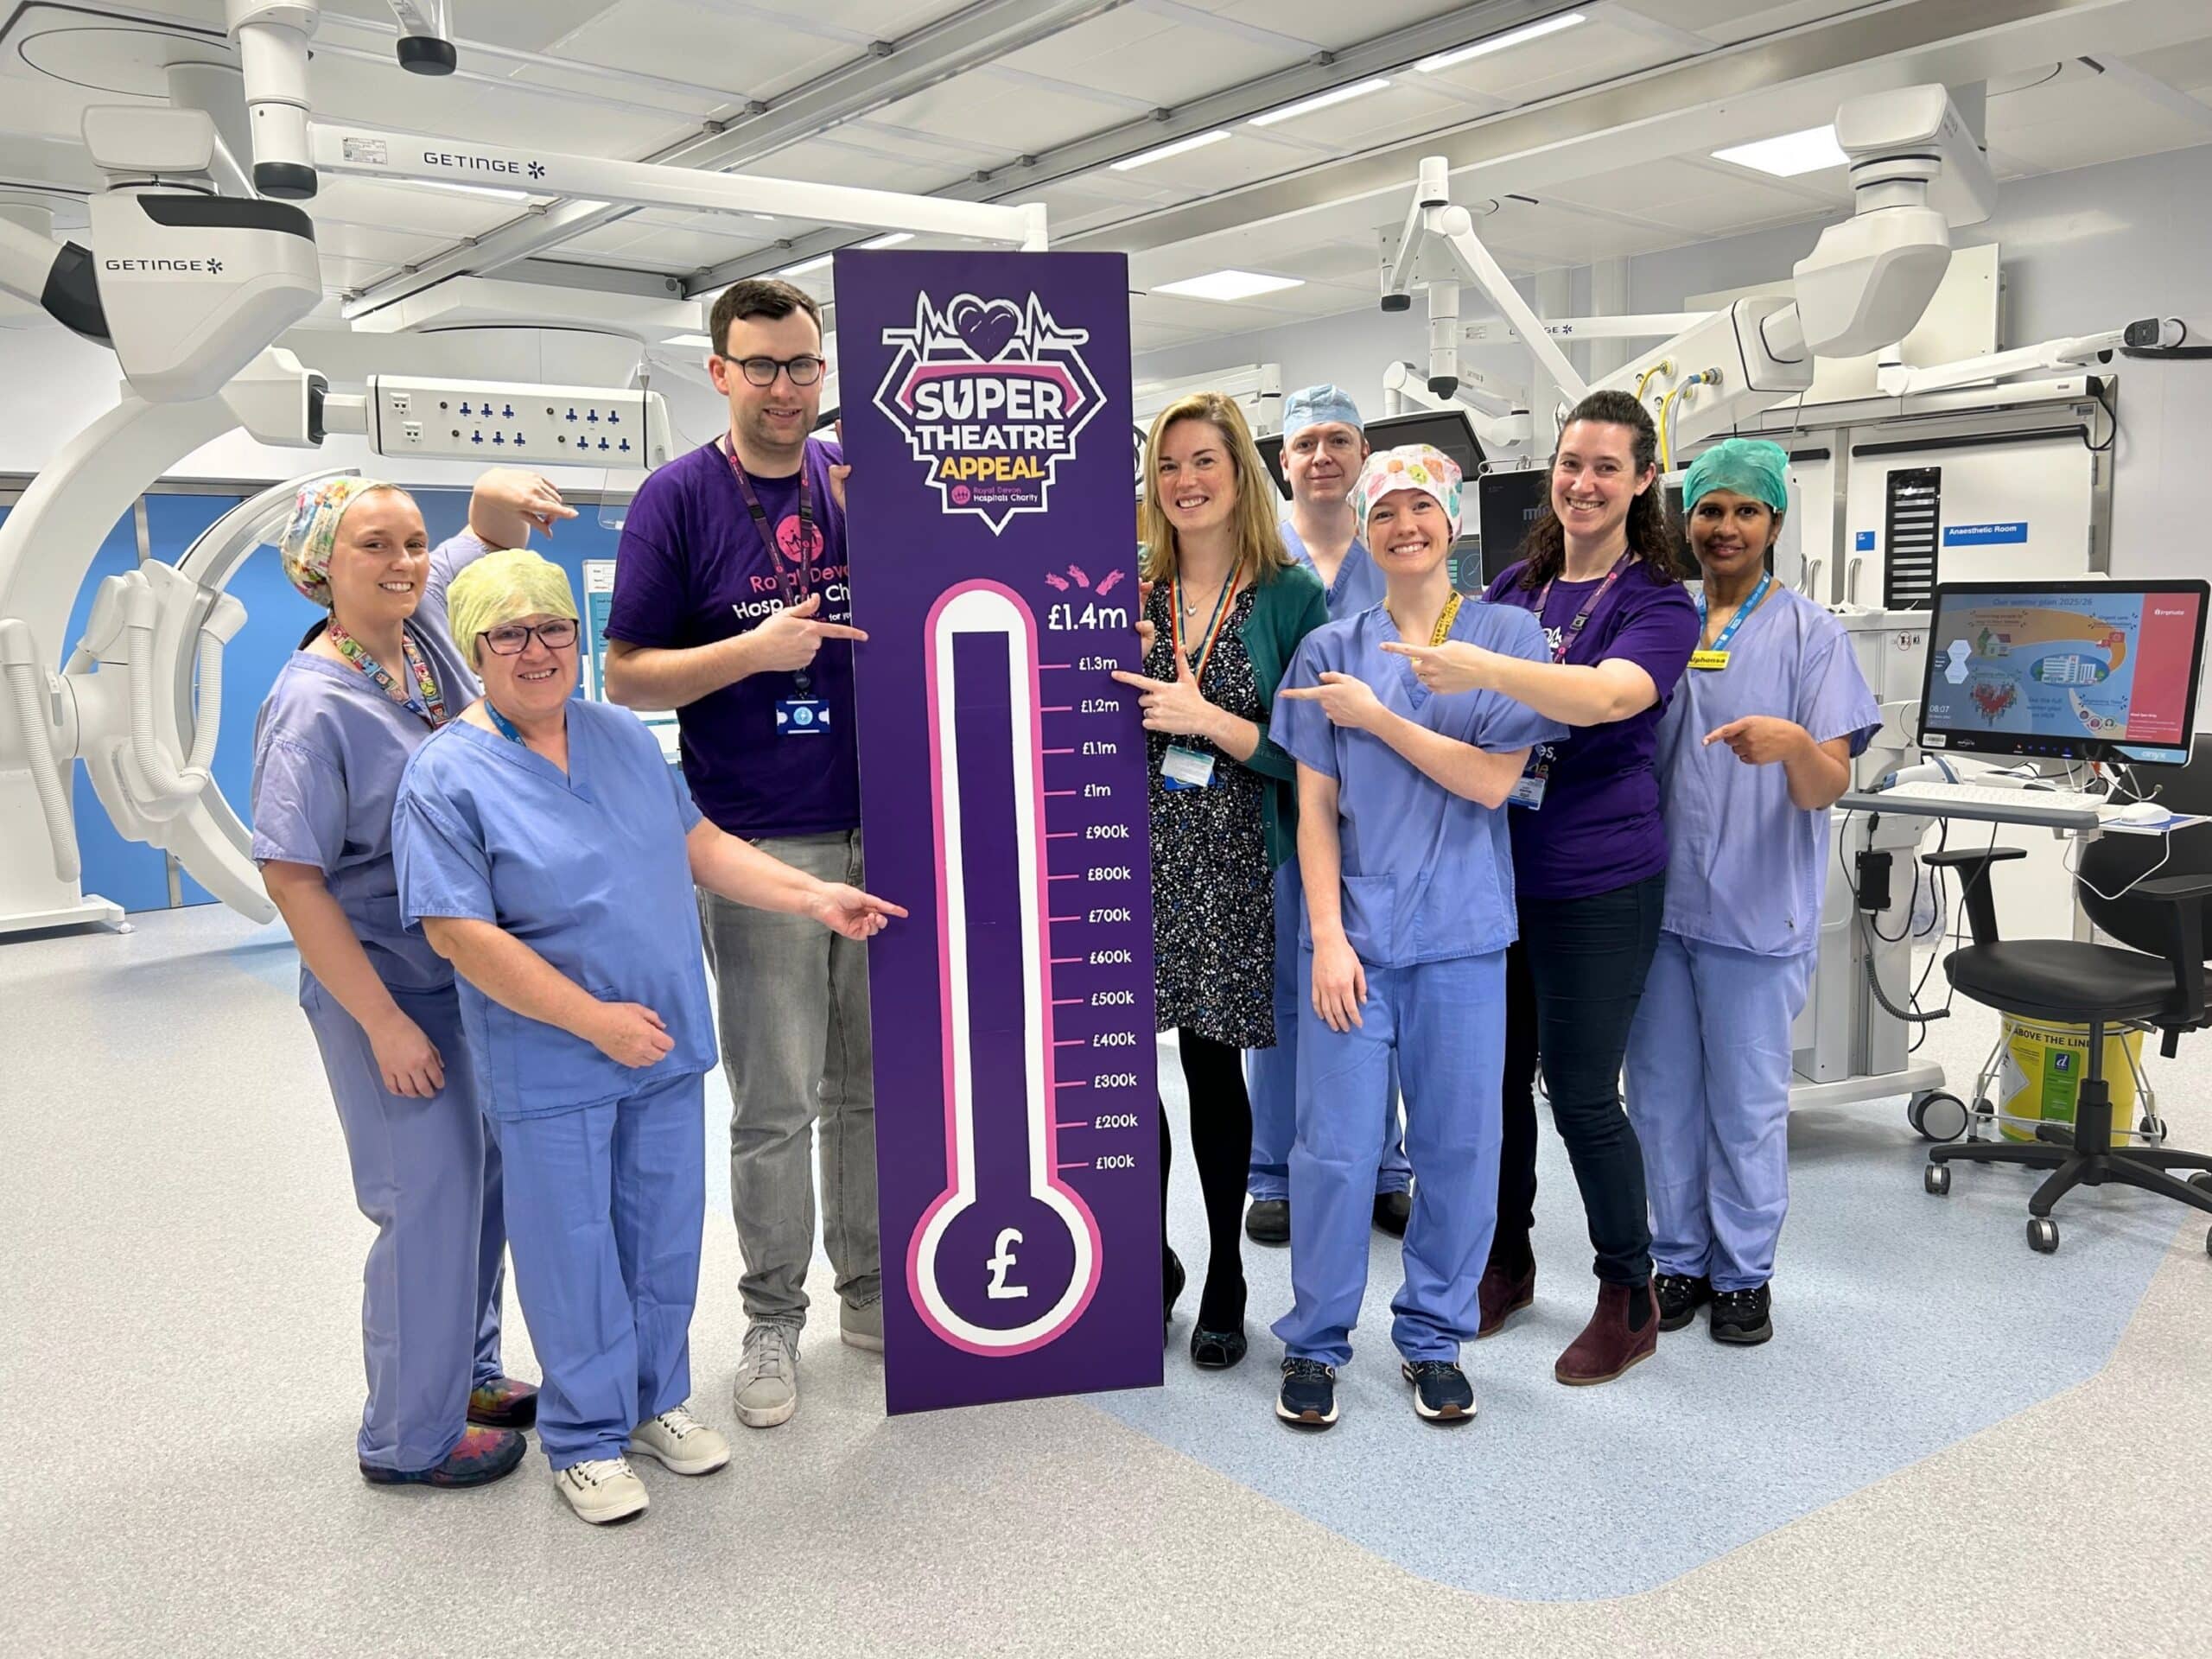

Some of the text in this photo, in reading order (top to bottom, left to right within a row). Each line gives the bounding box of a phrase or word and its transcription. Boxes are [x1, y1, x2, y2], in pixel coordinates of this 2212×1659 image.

[423, 152, 520, 174] GETINGE
[105, 259, 202, 271] GETINGE
[915, 378, 1064, 421] SUPER
[915, 425, 1066, 450] THEATRE
[939, 455, 1046, 481] APPEAL
[973, 486, 995, 496] Royal
[973, 493, 1038, 504] Hospitals Charity
[1948, 524, 2018, 536] Anaesthetic Room
[1048, 602, 1128, 631] £1.4m
[1079, 656, 1118, 671] £1.3m
[1081, 698, 1120, 713] £1.2m
[1083, 741, 1117, 755] £1.1m
[1084, 784, 1111, 798] £1m
[1085, 824, 1130, 840] £900k
[1087, 866, 1132, 881] £800k
[1089, 907, 1132, 923] £700k
[1090, 949, 1133, 964] £600k
[1091, 990, 1135, 1006] £500k
[1092, 1032, 1137, 1047] £400k
[2013, 1028, 2043, 1041] ABOVE
[2044, 1034, 2065, 1046] THE
[1094, 1072, 1138, 1089] £300k
[1095, 1113, 1139, 1129] £200k
[1096, 1154, 1135, 1170] £100k
[986, 1227, 1029, 1300] £
